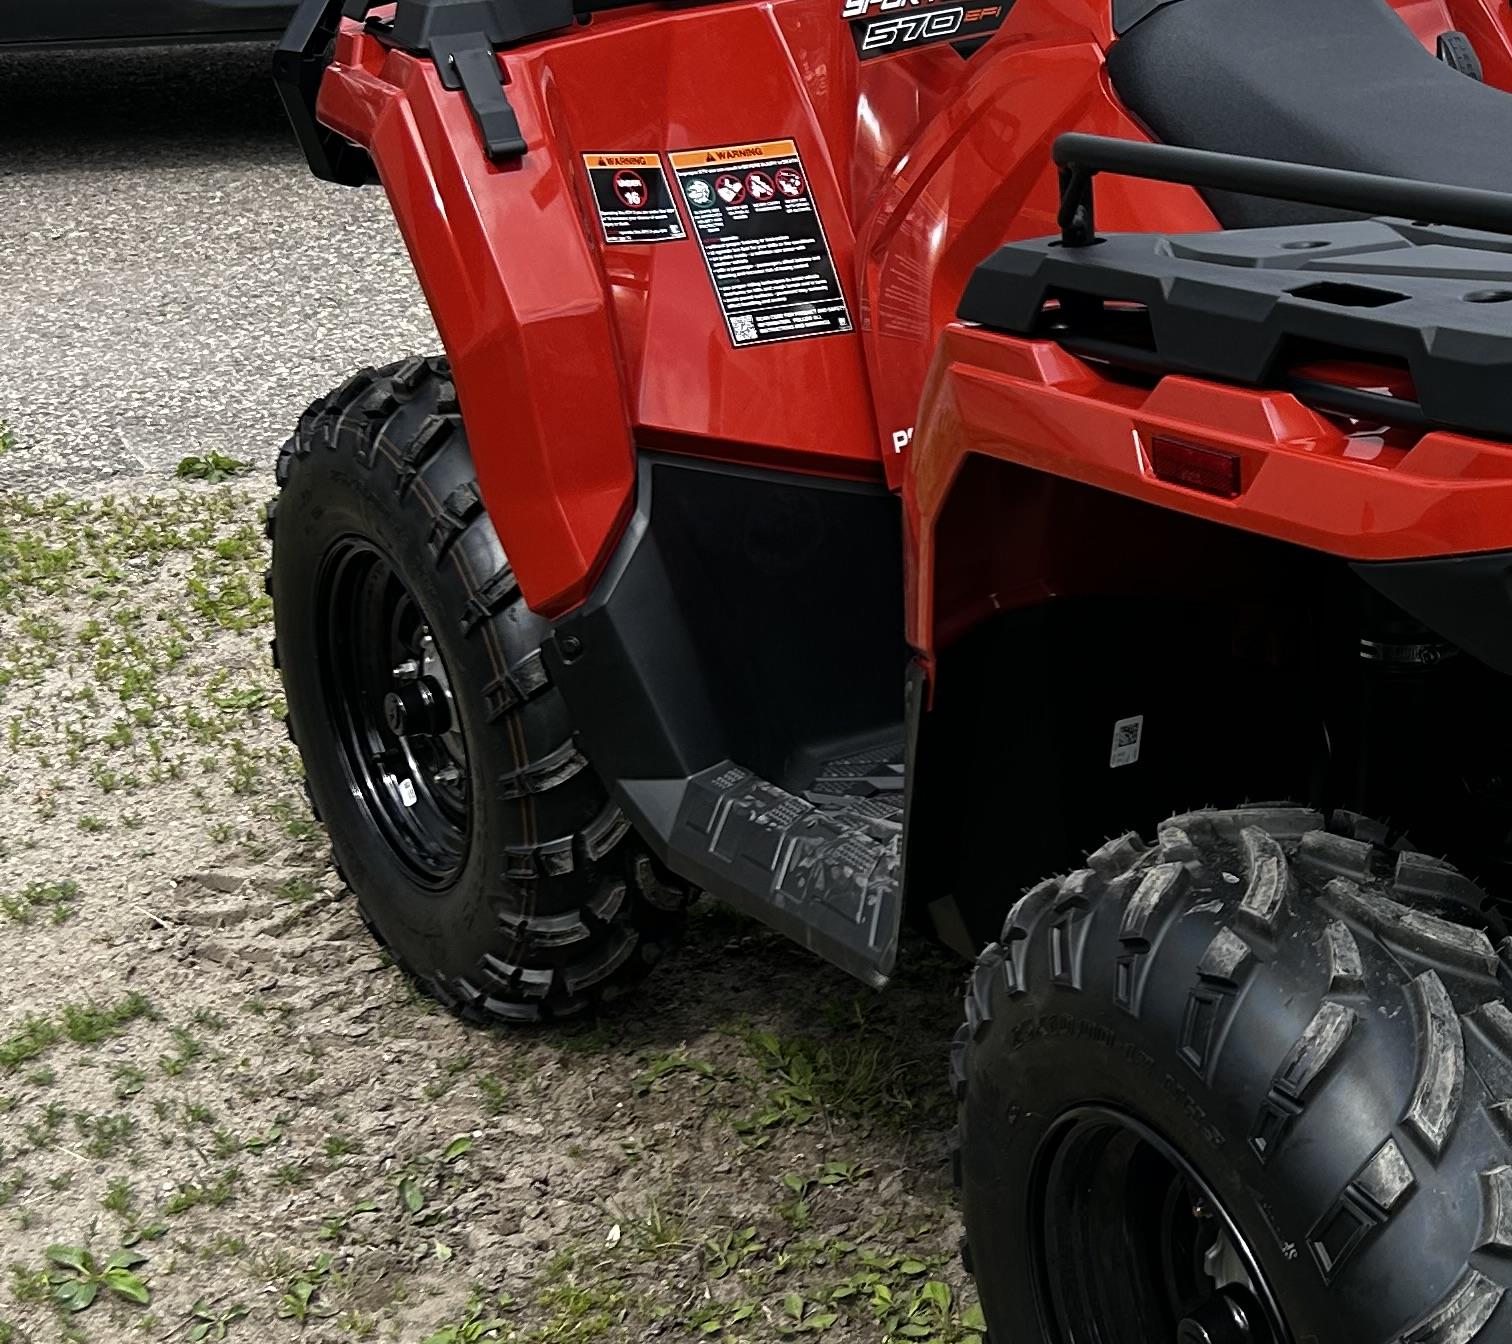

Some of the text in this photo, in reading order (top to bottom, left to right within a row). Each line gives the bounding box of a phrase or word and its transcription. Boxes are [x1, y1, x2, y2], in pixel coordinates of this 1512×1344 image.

[862, 6, 1002, 50] 570 EFI
[606, 156, 647, 166] WARNING
[715, 147, 763, 161] WARNING
